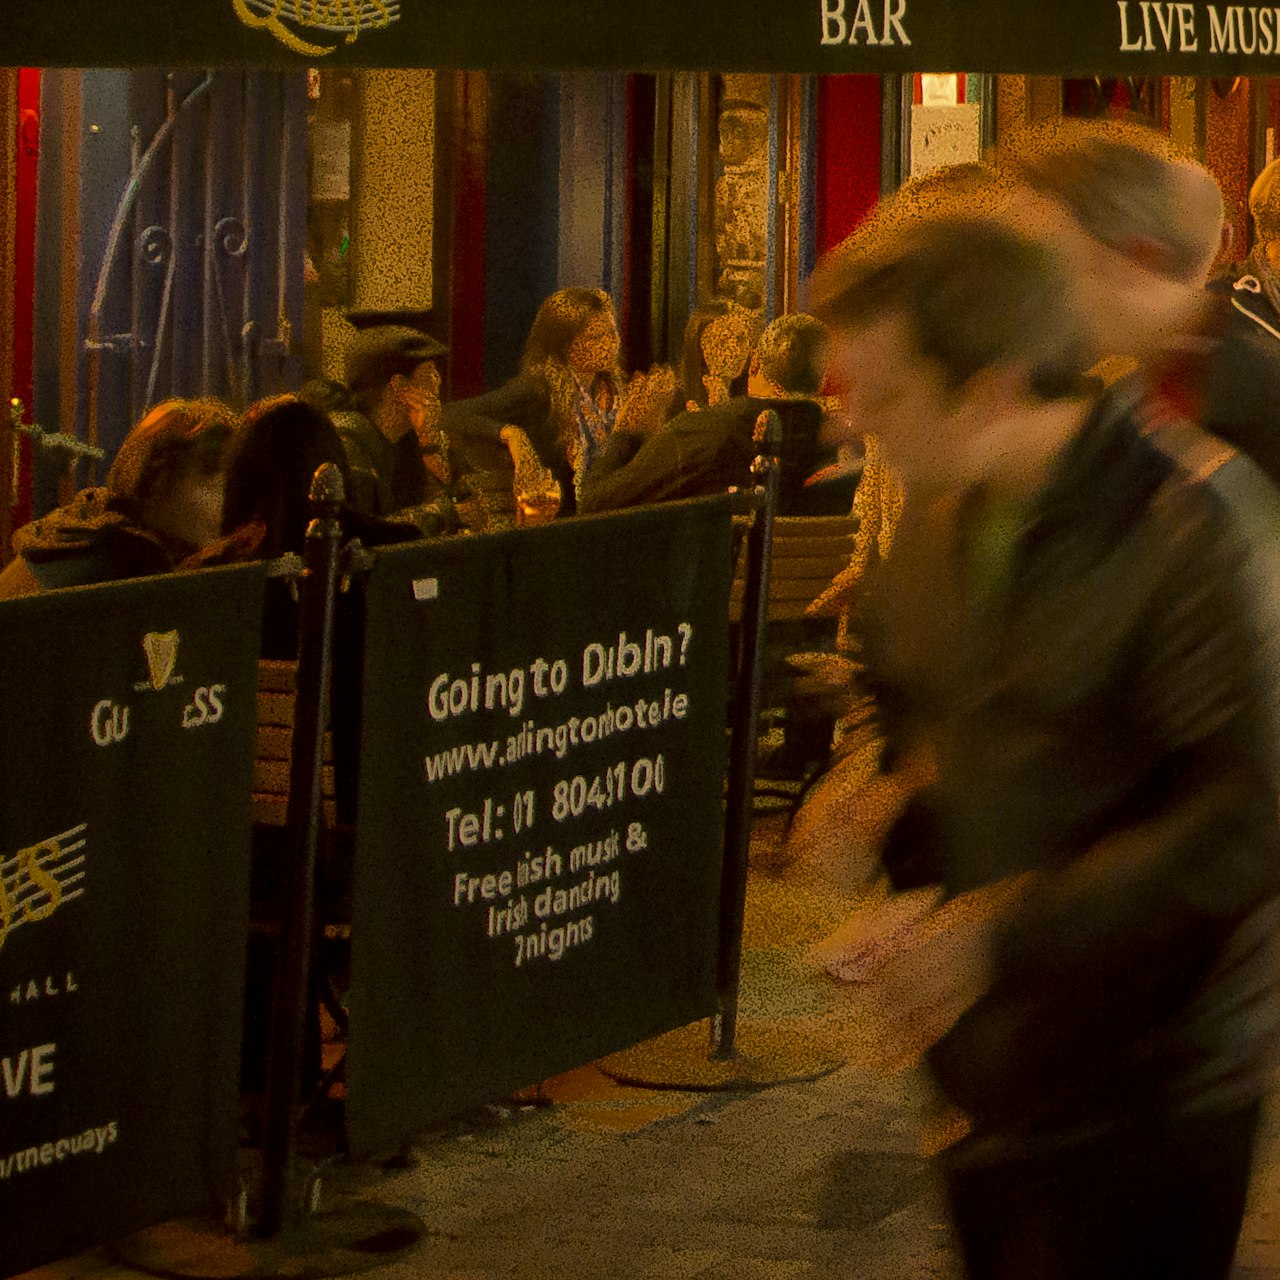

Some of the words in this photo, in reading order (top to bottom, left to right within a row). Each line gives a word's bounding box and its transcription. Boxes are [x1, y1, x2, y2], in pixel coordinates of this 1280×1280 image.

[1117, 0, 1199, 54] LIVE
[428, 662, 525, 722] Going
[530, 657, 567, 698] to
[446, 797, 504, 852] Tel:
[453, 869, 513, 907] Free
[626, 821, 648, 854] &
[488, 898, 529, 938] Irish
[534, 869, 620, 919] dancing
